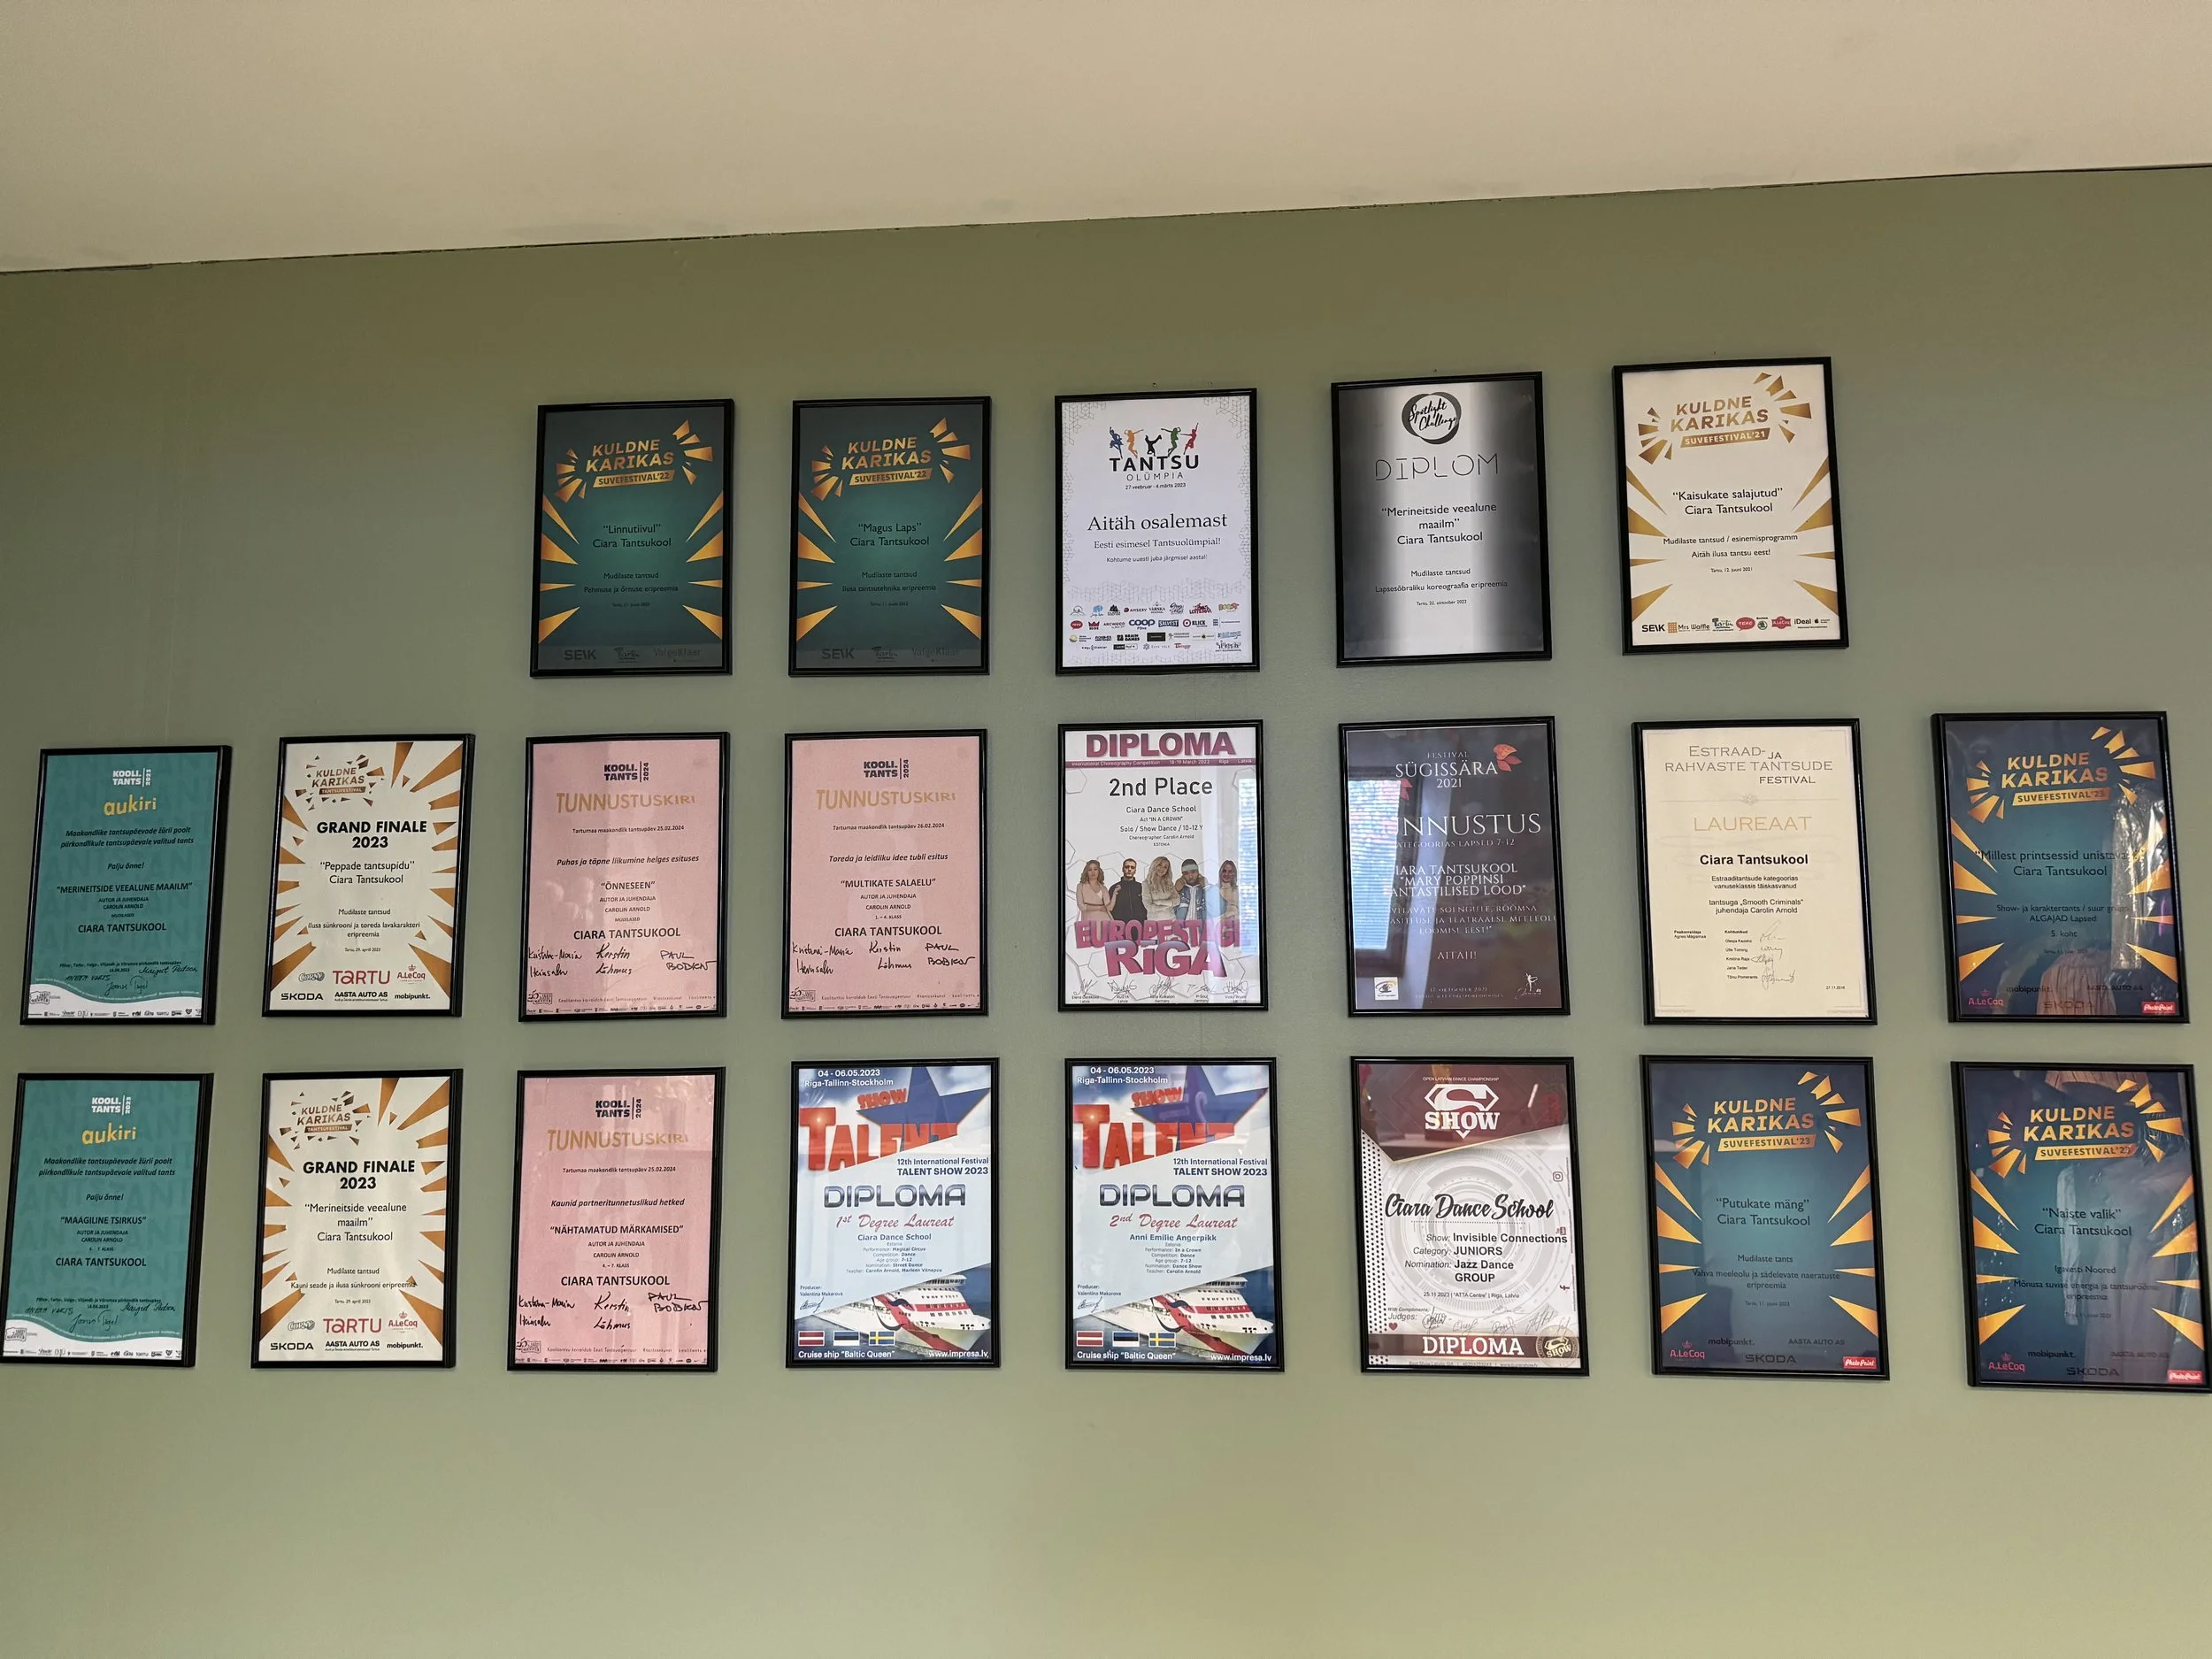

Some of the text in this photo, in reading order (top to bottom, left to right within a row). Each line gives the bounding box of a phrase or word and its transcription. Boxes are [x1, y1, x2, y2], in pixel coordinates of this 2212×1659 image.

[1409, 398, 1447, 422] Spotlight
[1676, 396, 1751, 416] KULDNE
[1419, 415, 1457, 431] Challenge
[1671, 410, 1768, 432] KARIKAS
[592, 439, 659, 456] KULDNE
[586, 452, 674, 472] KARIKAS
[1110, 455, 1199, 472] TANTSU
[1376, 453, 1498, 480] DIPLOM
[1126, 472, 1183, 481] OLÜMPIA
[1453, 503, 1496, 513] veealune
[1087, 513, 1227, 531] Aitäh osalemast
[593, 537, 672, 548] Ciara Tantsukool
[850, 536, 929, 547] Ciara Tantsukool
[1153, 537, 1221, 547] Tantsuolümpial!
[1427, 582, 1469, 591] koreograafia
[1471, 580, 1507, 589] eripreemia
[1086, 732, 1236, 757] DIPLOMA
[1395, 759, 1497, 778] SÜGISSÄRA
[1665, 761, 1832, 772] RAHVASTE TANTSUDE
[2007, 753, 2089, 770] KULDNE
[1437, 779, 1462, 787] 2021
[2001, 767, 2108, 788] KARIKAS
[1110, 777, 1212, 796] 2nd Place
[104, 795, 156, 816] aukiri
[557, 793, 695, 813] TUNNUSTUSKIRI
[317, 821, 426, 833] GRAND FINALE
[1387, 813, 1541, 836] NNUSTUS
[1694, 817, 1812, 831] LAUREAAT
[352, 836, 388, 849] 2023
[589, 857, 610, 866] täpne
[647, 856, 670, 864] helges
[1700, 854, 1809, 865] Ciara Tantsukool
[2014, 866, 2107, 876] Ciara Tantsukool
[1446, 874, 1503, 885] POPPINSI
[2030, 914, 2096, 923] ALGAJAD Lapsed
[78, 923, 166, 933] CIARA TANTSUKOOL
[395, 992, 430, 1001] mobipunkt.
[805, 1079, 894, 1087] Riga-Tallinn-Stockholm
[857, 1088, 907, 1108] SHOW
[1714, 1098, 1795, 1115] KULDNE
[1425, 1111, 1500, 1130] SHOW
[1708, 1113, 1814, 1133] KARIKAS
[82, 1123, 136, 1144] aukiri
[799, 1107, 957, 1172] TALENT
[303, 1160, 415, 1174] GRAND FINALE
[1211, 1167, 1240, 1176] SHOW
[1243, 1167, 1267, 1176] 2023
[340, 1177, 376, 1189] 2023
[824, 1184, 965, 1208] DIPLOMA
[1385, 1193, 1554, 1219] Ciara Dance School
[836, 1213, 955, 1232] 1st Degree Laureat
[2034, 1224, 2131, 1236] Ciara Tantsukool
[1176, 1233, 1217, 1242] Angerpikk
[1453, 1233, 1497, 1242] Invisible
[1501, 1233, 1568, 1243] Connections
[1413, 1247, 1502, 1256] Category: JUNIORS
[561, 1275, 670, 1286] CIARA TANTSUKOOL
[1455, 1273, 1495, 1282] GROUP
[1423, 1336, 1524, 1356] DIPLOMA
[822, 1350, 839, 1359] ship
[1210, 1353, 1271, 1363] www.impresa.lv
